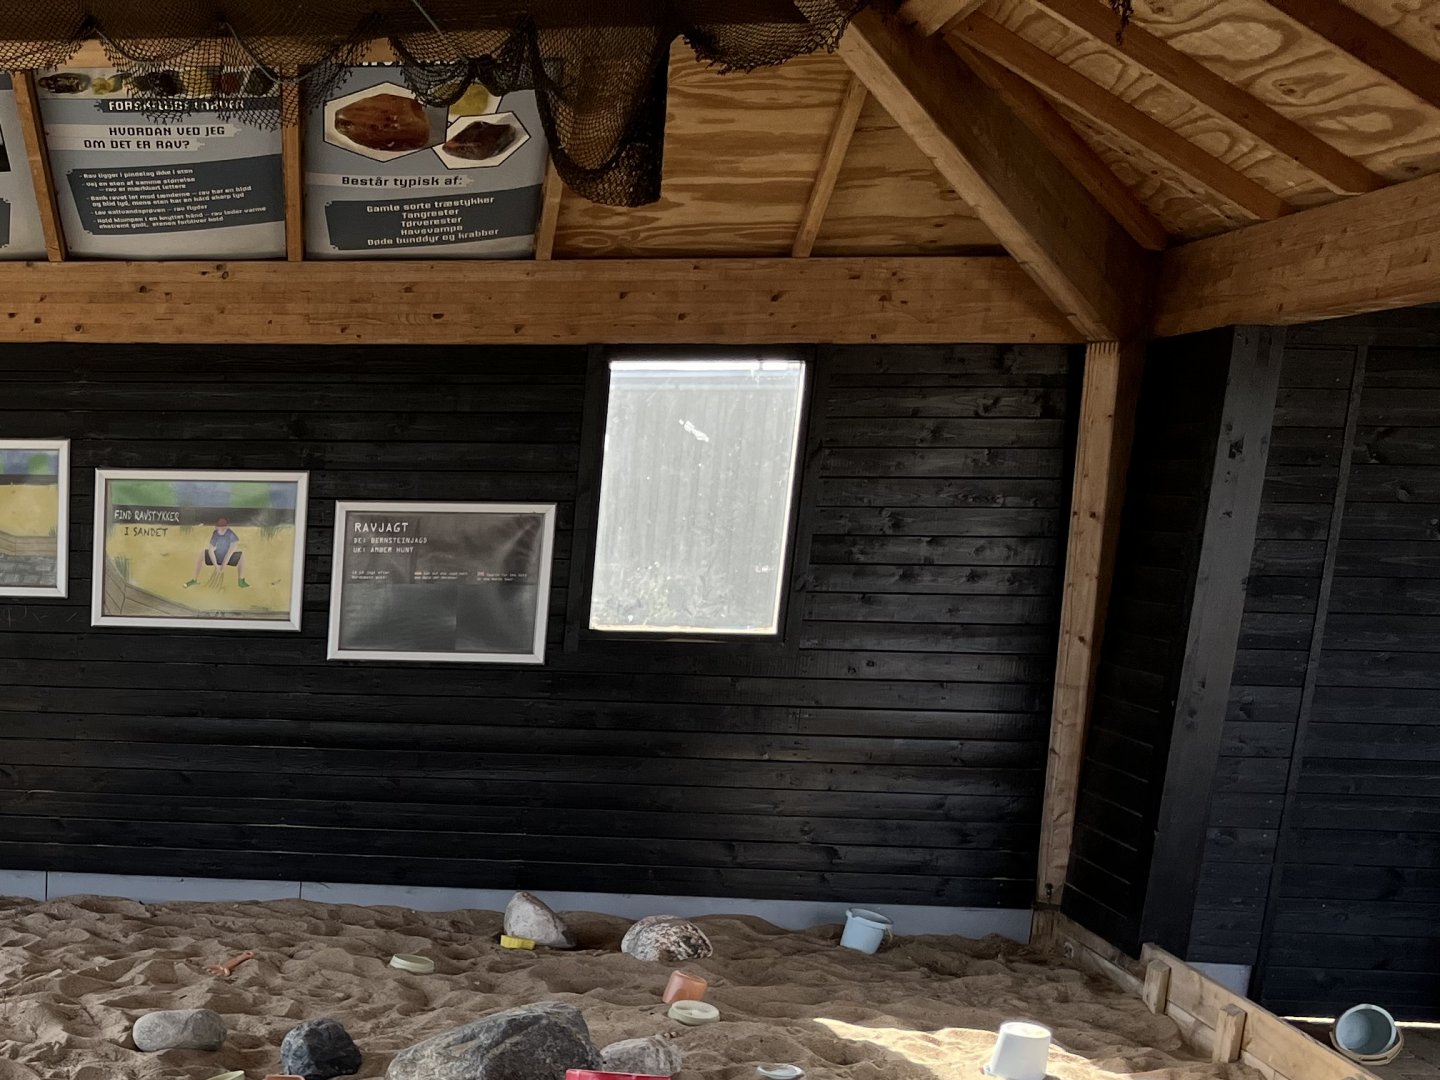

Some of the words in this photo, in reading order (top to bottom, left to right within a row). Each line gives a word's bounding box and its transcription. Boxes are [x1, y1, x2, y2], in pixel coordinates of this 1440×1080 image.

[109, 127, 172, 137] HVORDAN
[176, 127, 201, 136] VED
[205, 126, 225, 137] JEG
[84, 139, 106, 149] OM
[110, 140, 132, 149] DET
[136, 140, 151, 149] ER
[156, 140, 190, 149] RAV?
[341, 176, 389, 187] Består
[393, 176, 440, 188] typisk
[444, 176, 463, 185] af:
[366, 205, 400, 213] Gamle
[403, 202, 432, 211] sorte
[434, 196, 495, 208] træstykker
[401, 209, 460, 219] Tangrester
[400, 217, 463, 228] Tørverester
[400, 225, 463, 236] Havsvampe
[367, 238, 393, 246] Døde
[396, 234, 440, 244] bunddyr
[458, 229, 499, 239] krabber
[114, 510, 133, 520] FIND
[135, 509, 180, 522] RAVSTYKKER
[124, 526, 129, 536] I
[133, 526, 168, 537] SANDET
[354, 522, 409, 533] RAVJAGT
